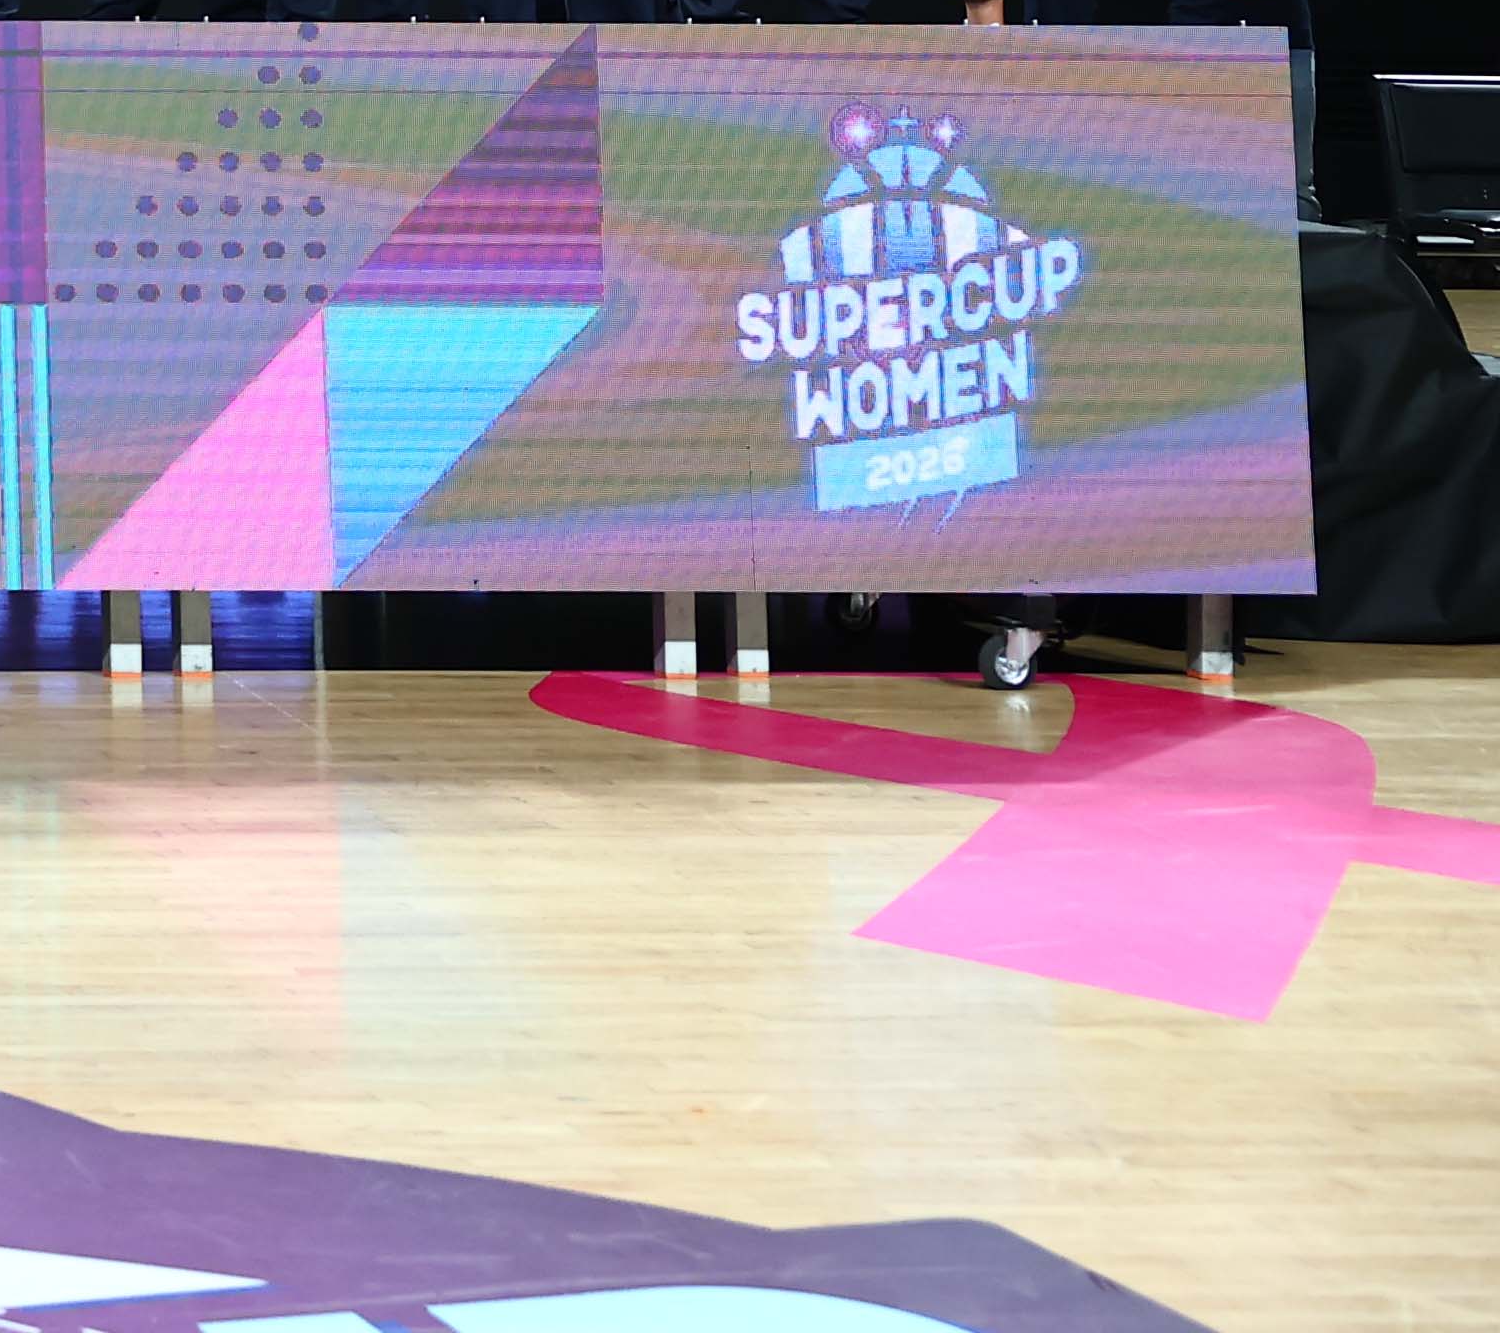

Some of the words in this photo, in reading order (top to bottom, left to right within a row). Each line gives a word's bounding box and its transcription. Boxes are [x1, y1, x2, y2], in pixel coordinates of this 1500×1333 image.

[736, 236, 1085, 363] SUPERCUP
[793, 331, 1034, 441] WOMEN
[866, 441, 968, 488] 2026
